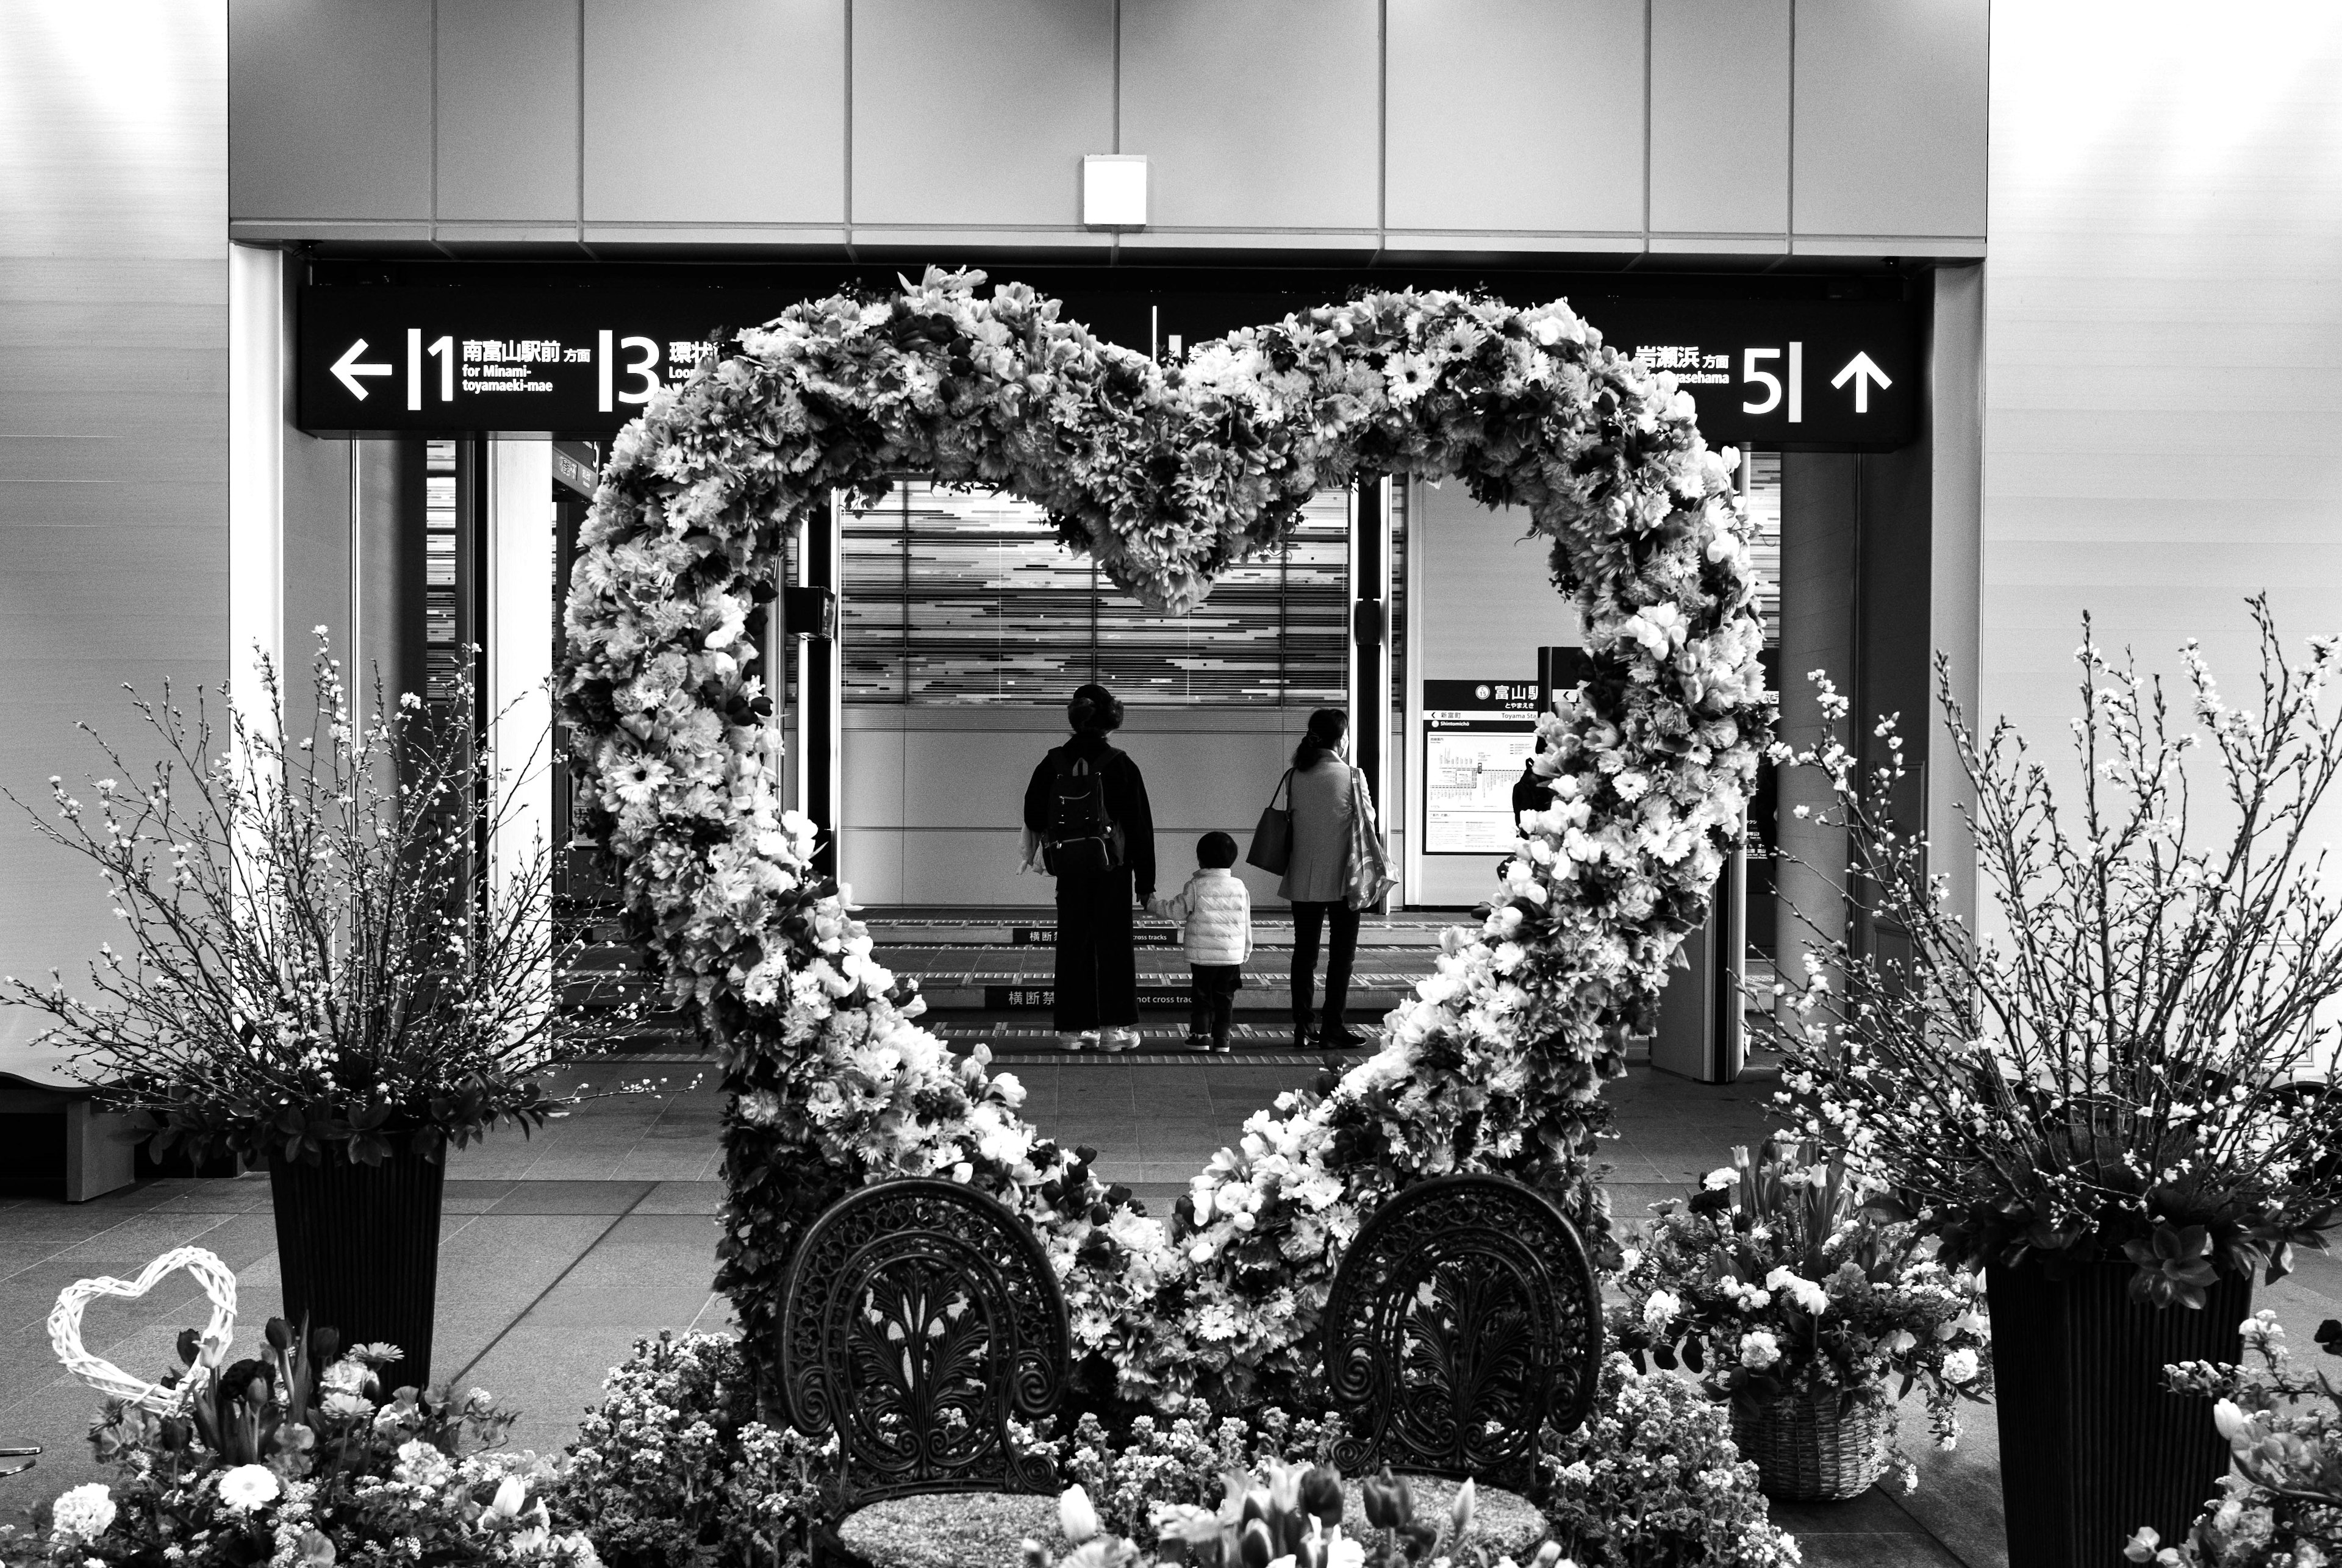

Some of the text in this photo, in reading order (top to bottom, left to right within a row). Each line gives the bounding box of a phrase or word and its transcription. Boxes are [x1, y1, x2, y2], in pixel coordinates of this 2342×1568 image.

[462, 339, 591, 362] 南富山駅前 方面
[669, 341, 718, 363] 環状
[1635, 345, 1730, 369] 岩瀬浜 方面
[428, 335, 453, 401] 1
[462, 364, 532, 377] for Minami-
[618, 336, 660, 403] 3
[1677, 371, 1730, 384] asehama
[462, 379, 553, 394] toyamaeki-mae
[1742, 348, 1782, 414] 5
[1009, 991, 1055, 1006] 横断禁
